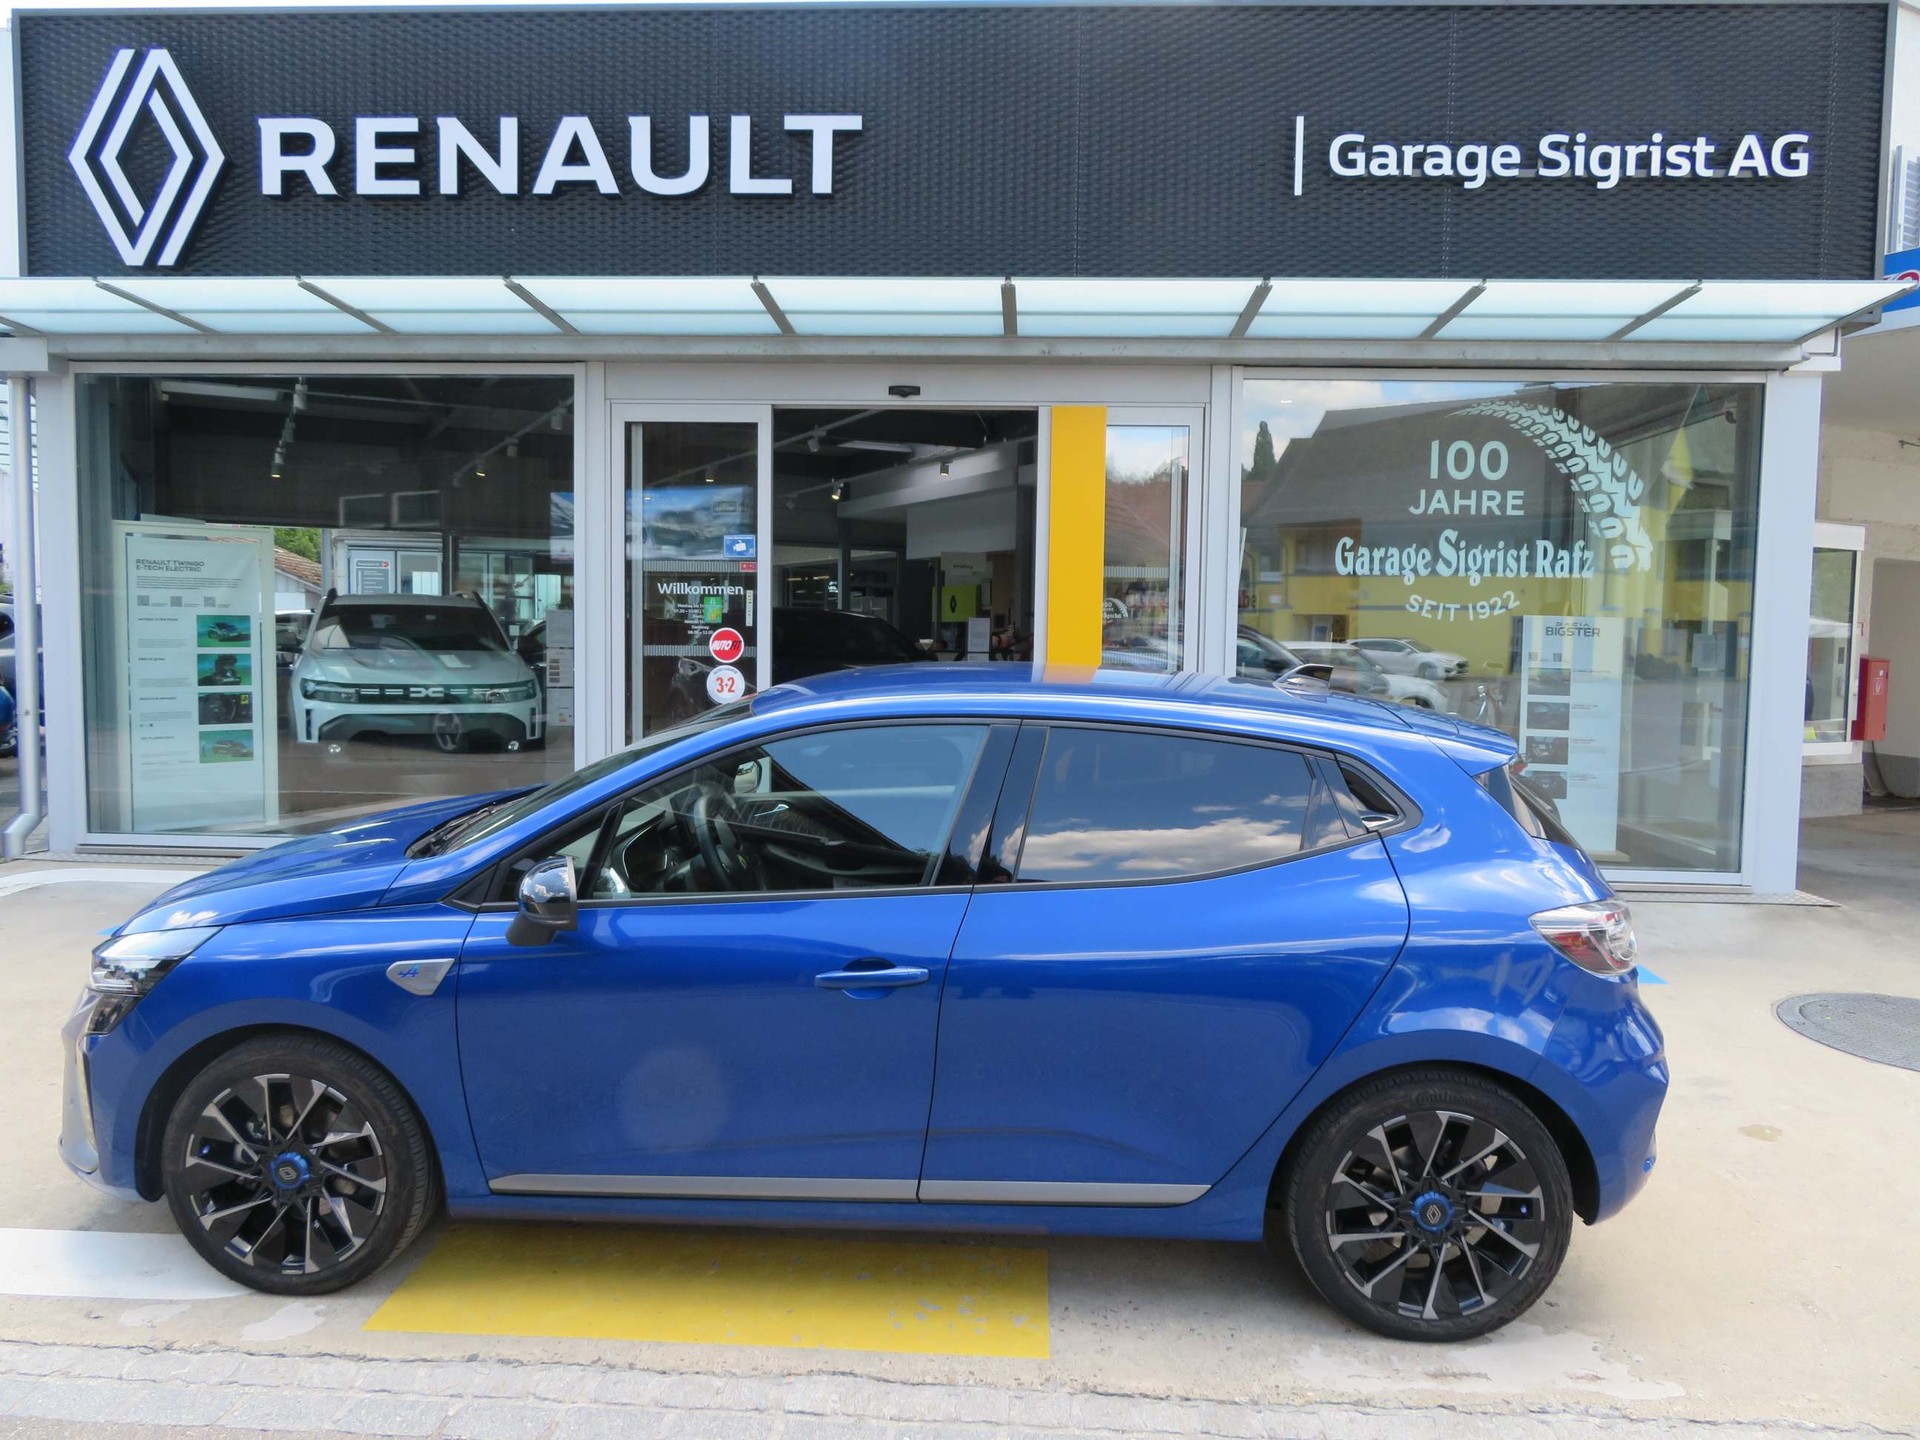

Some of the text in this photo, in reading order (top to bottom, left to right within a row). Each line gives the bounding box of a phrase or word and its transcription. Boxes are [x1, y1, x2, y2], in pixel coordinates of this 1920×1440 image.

[258, 115, 863, 196] RENAULT
[1328, 132, 1810, 189] Garage Sigrist AG
[1429, 439, 1509, 481] 100
[1408, 489, 1525, 516] JAHRE
[136, 559, 205, 568] RENAULT TWINGO
[1334, 528, 1595, 587] Garage Sigrist Rafz
[657, 582, 744, 595] Willkommen
[1405, 590, 1520, 622] SEIT 1922
[1545, 626, 1601, 637] BIGSTER
